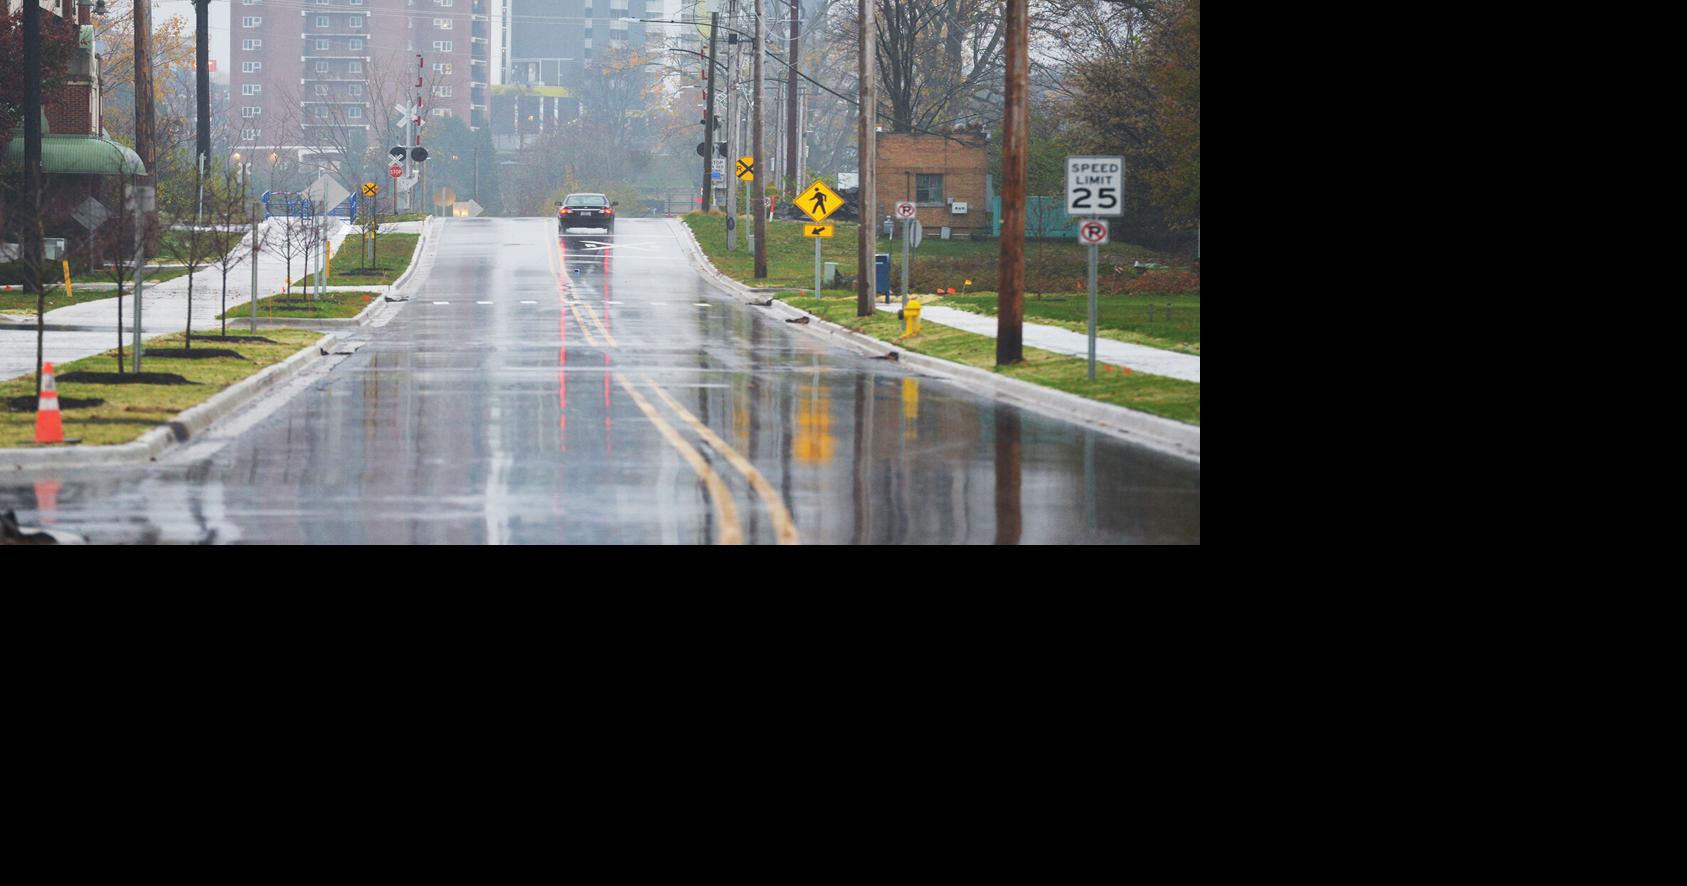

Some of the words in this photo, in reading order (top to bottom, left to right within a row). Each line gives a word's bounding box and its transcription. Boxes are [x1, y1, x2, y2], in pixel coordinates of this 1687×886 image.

[1071, 163, 1119, 173] SPEED
[1075, 176, 1113, 185] LIMIT
[1072, 187, 1117, 209] 25
[1088, 225, 1101, 238] P
